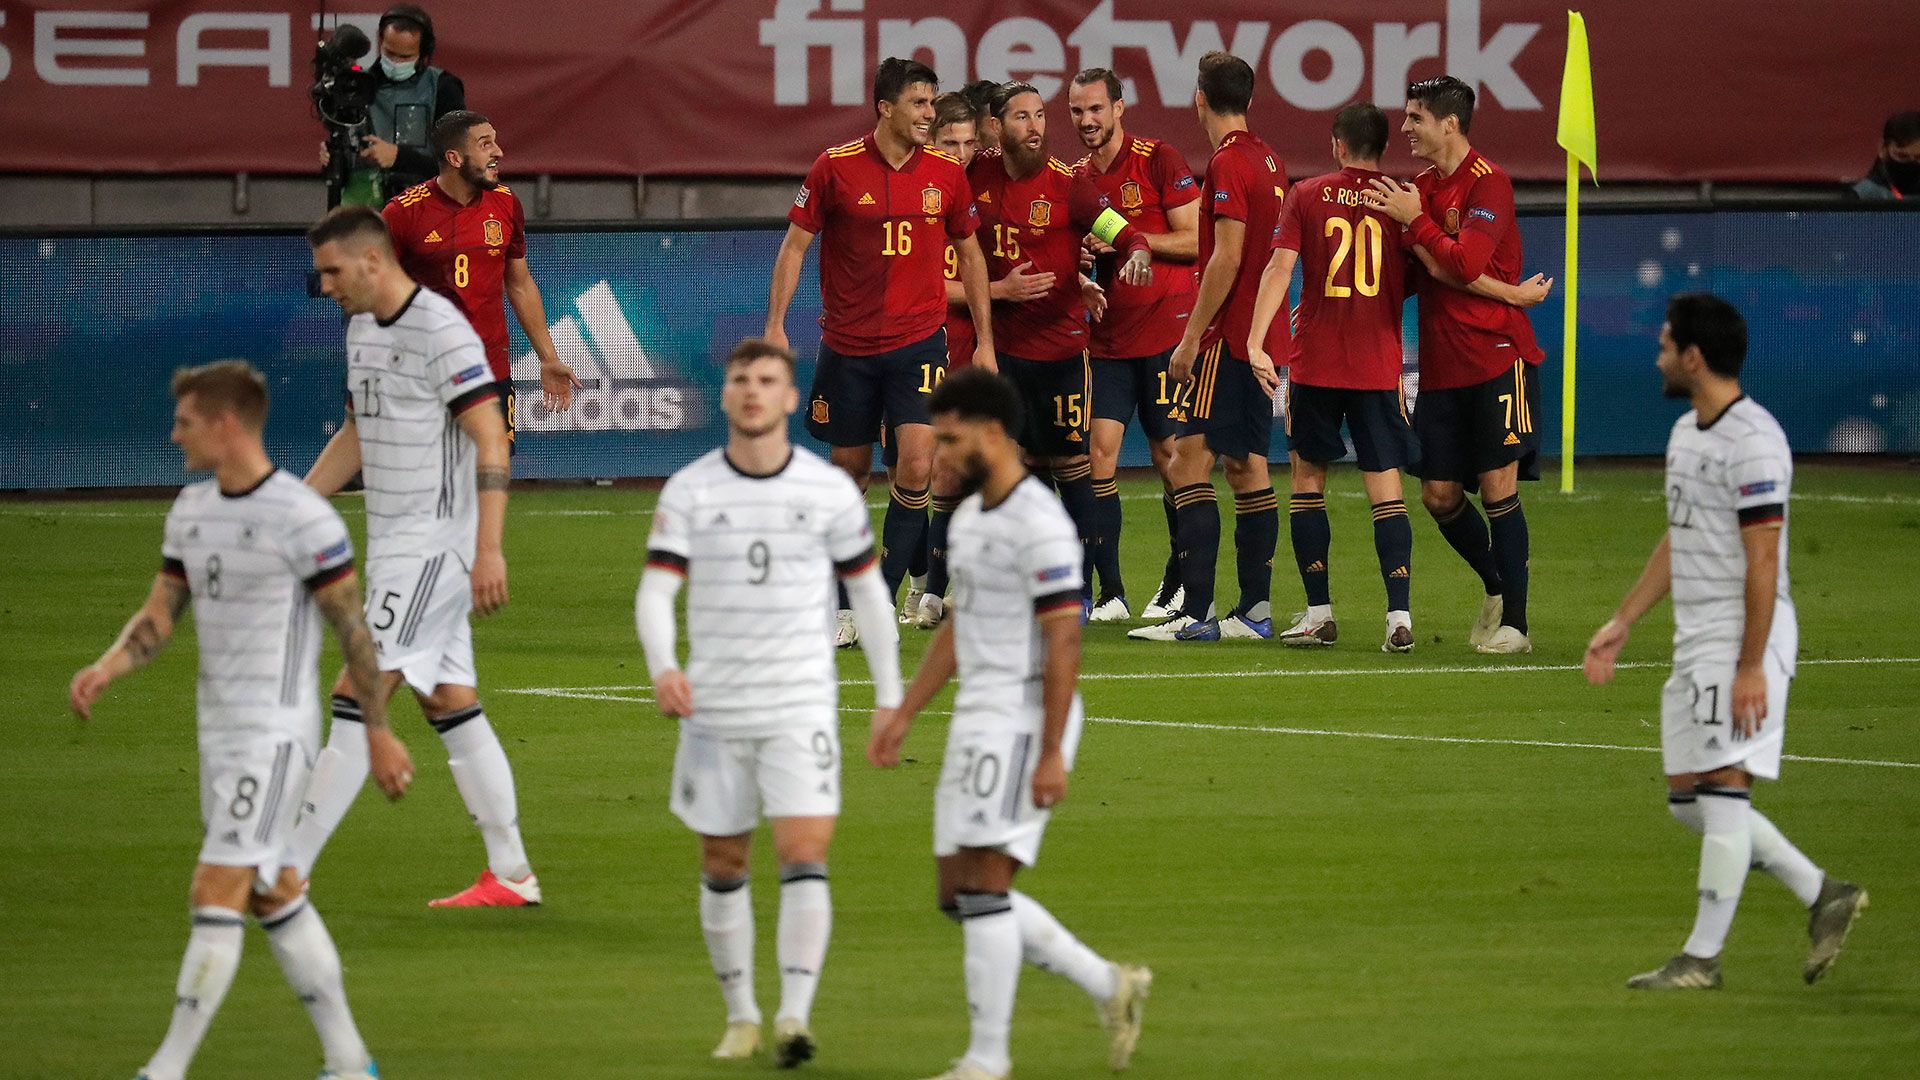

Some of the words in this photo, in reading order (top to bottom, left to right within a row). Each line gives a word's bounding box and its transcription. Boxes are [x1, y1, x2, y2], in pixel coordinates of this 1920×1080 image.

[759, 0, 1545, 112] finetwork
[881, 220, 913, 256] 16
[993, 223, 1021, 260] 15
[1324, 215, 1383, 298] 20
[455, 253, 469, 288] 8
[1053, 393, 1082, 428] 15
[1498, 394, 1513, 429] 7
[206, 553, 222, 600] 8
[748, 539, 771, 585] 9
[811, 730, 833, 770] 9
[229, 775, 258, 821] 8
